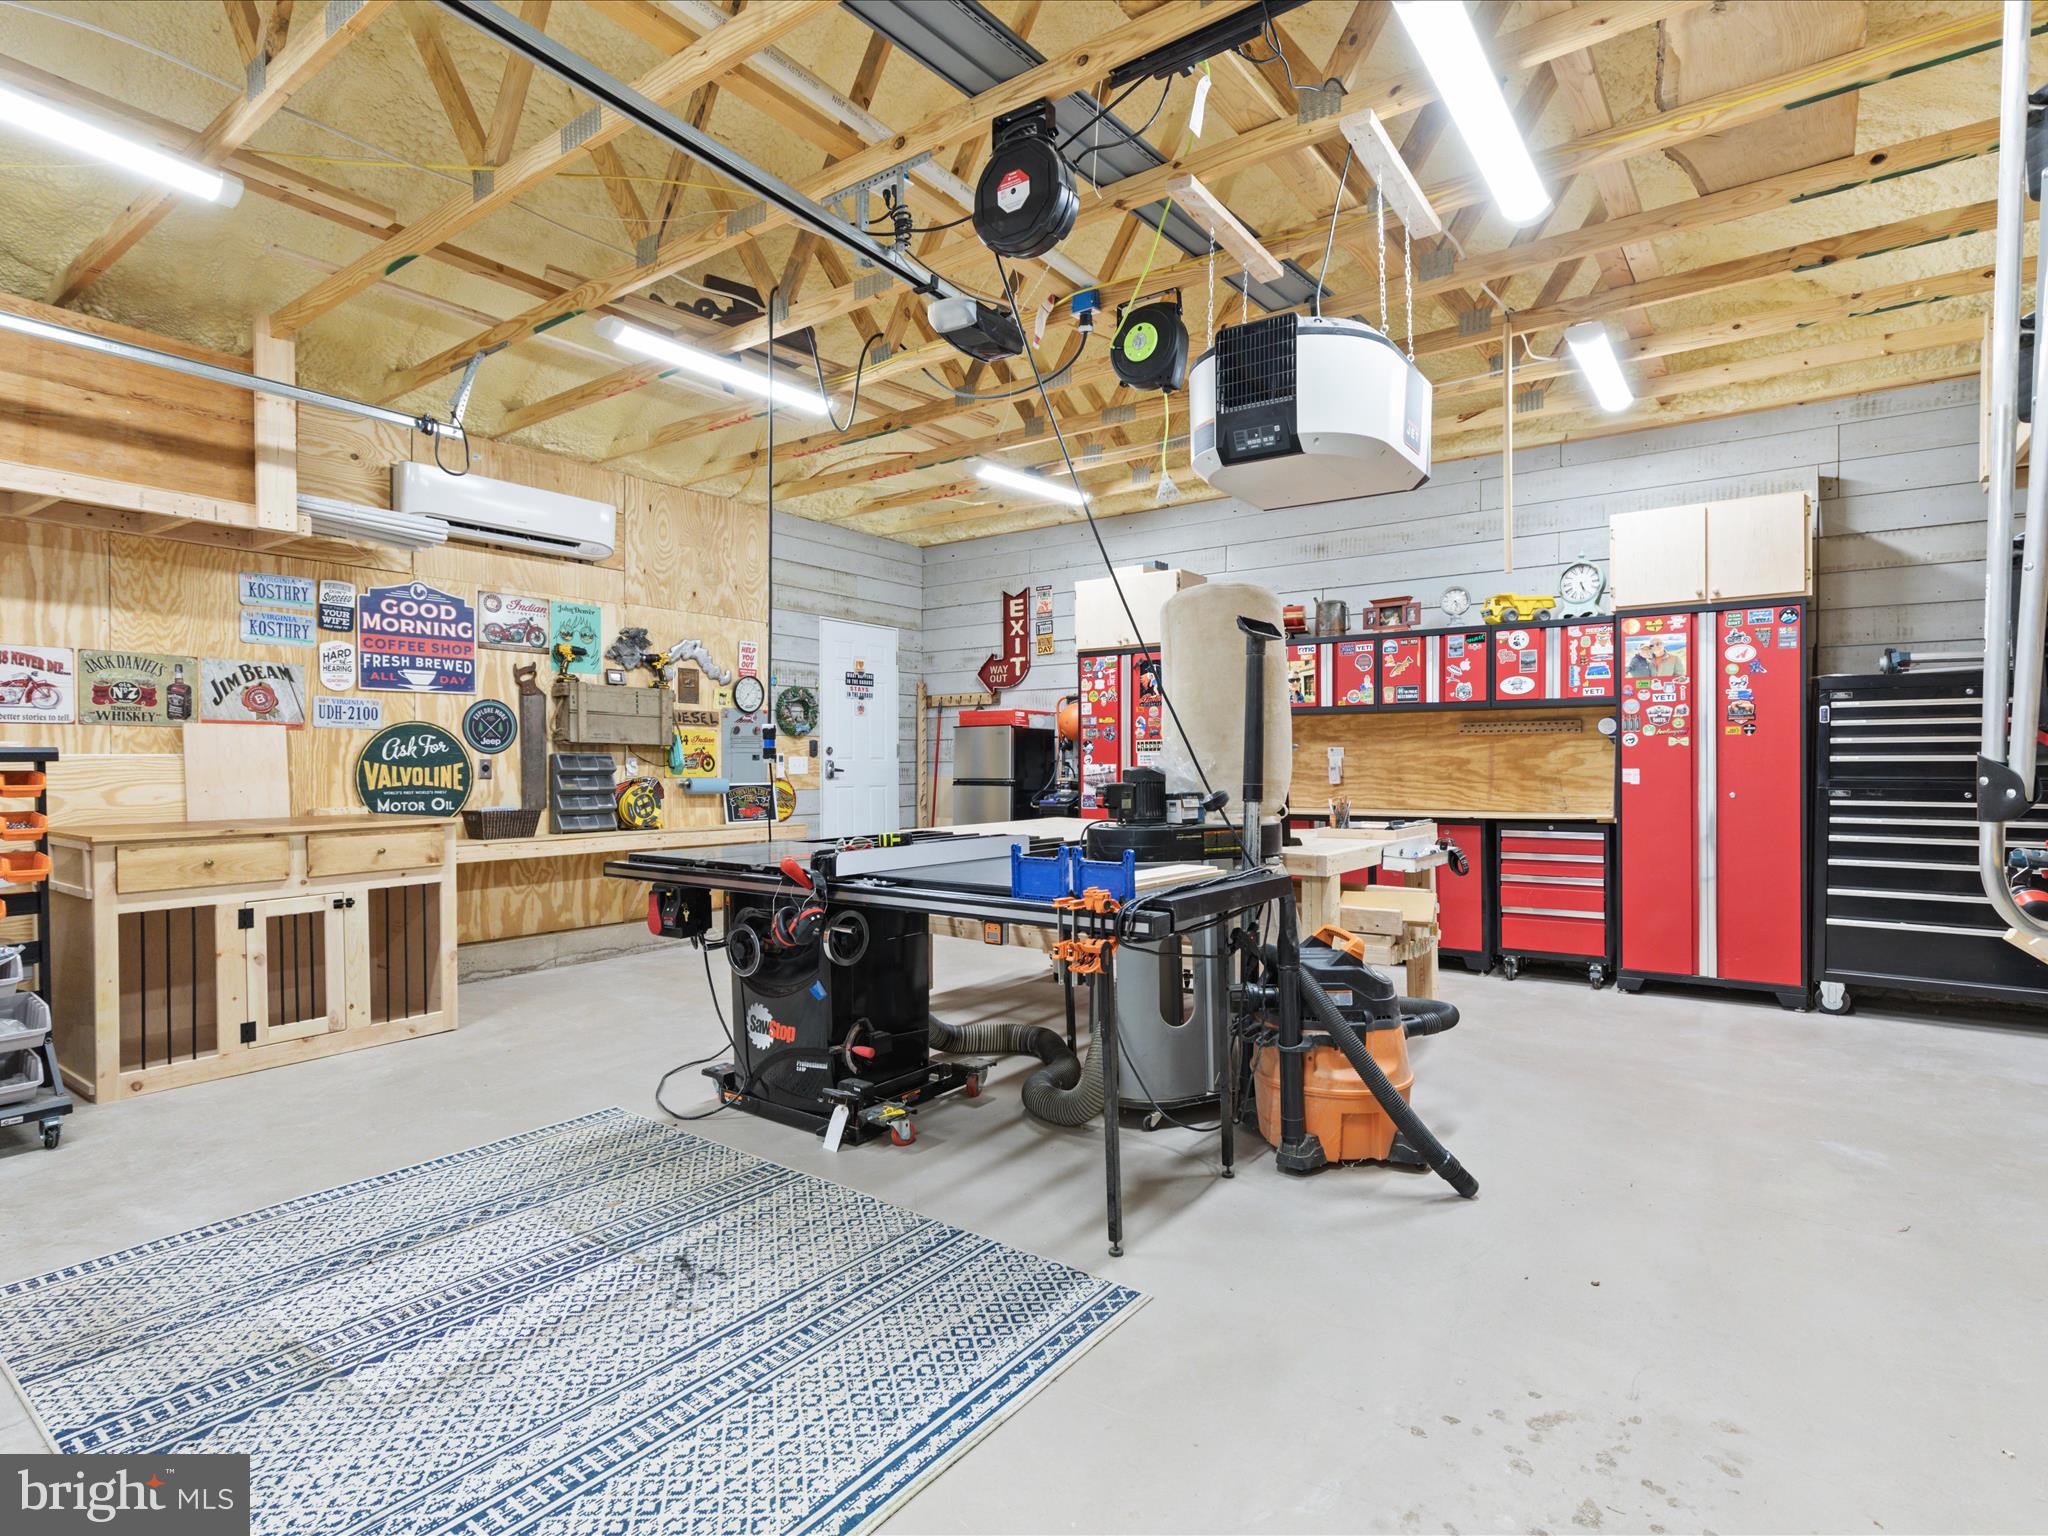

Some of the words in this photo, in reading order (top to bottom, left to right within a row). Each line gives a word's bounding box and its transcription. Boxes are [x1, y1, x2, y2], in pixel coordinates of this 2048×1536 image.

[260, 576, 296, 585] VIRGINIA
[322, 592, 352, 602] SUCCEED
[322, 609, 350, 618] YOUR
[380, 599, 457, 620] GOOD
[506, 599, 547, 614] Indian
[558, 605, 574, 614] John
[574, 607, 595, 615] Denver
[261, 613, 296, 622] VIRGINIA
[322, 616, 350, 626] WIFE
[362, 612, 473, 638] MORNING
[1010, 599, 1026, 676] EXIT
[363, 637, 426, 652] COFFEE
[431, 641, 472, 655] SHOP
[11, 651, 44, 671] NEVER
[323, 648, 351, 663] HARD
[85, 655, 115, 674] JACK
[363, 654, 410, 669] FRESH
[415, 658, 472, 675] BREWED
[990, 665, 1009, 674] WAY
[370, 672, 397, 681] ALL
[440, 676, 467, 685] DAY
[990, 674, 1008, 683] OUT
[210, 673, 241, 706] JIM
[239, 664, 295, 683] BEAM
[95, 710, 157, 722] WHISKEY
[319, 704, 378, 720] UDH-2100
[472, 707, 494, 721] EXPLORE
[495, 709, 508, 721] MORE
[678, 711, 719, 724] IESEL
[480, 737, 501, 746] Jeep
[691, 735, 715, 743] Indian
[382, 736, 418, 761] Ask
[418, 734, 450, 757] For
[363, 760, 464, 791] VALVOLINE
[377, 798, 425, 812] MOTOR
[431, 797, 455, 811] OIL
[749, 1014, 796, 1044] SawStop
